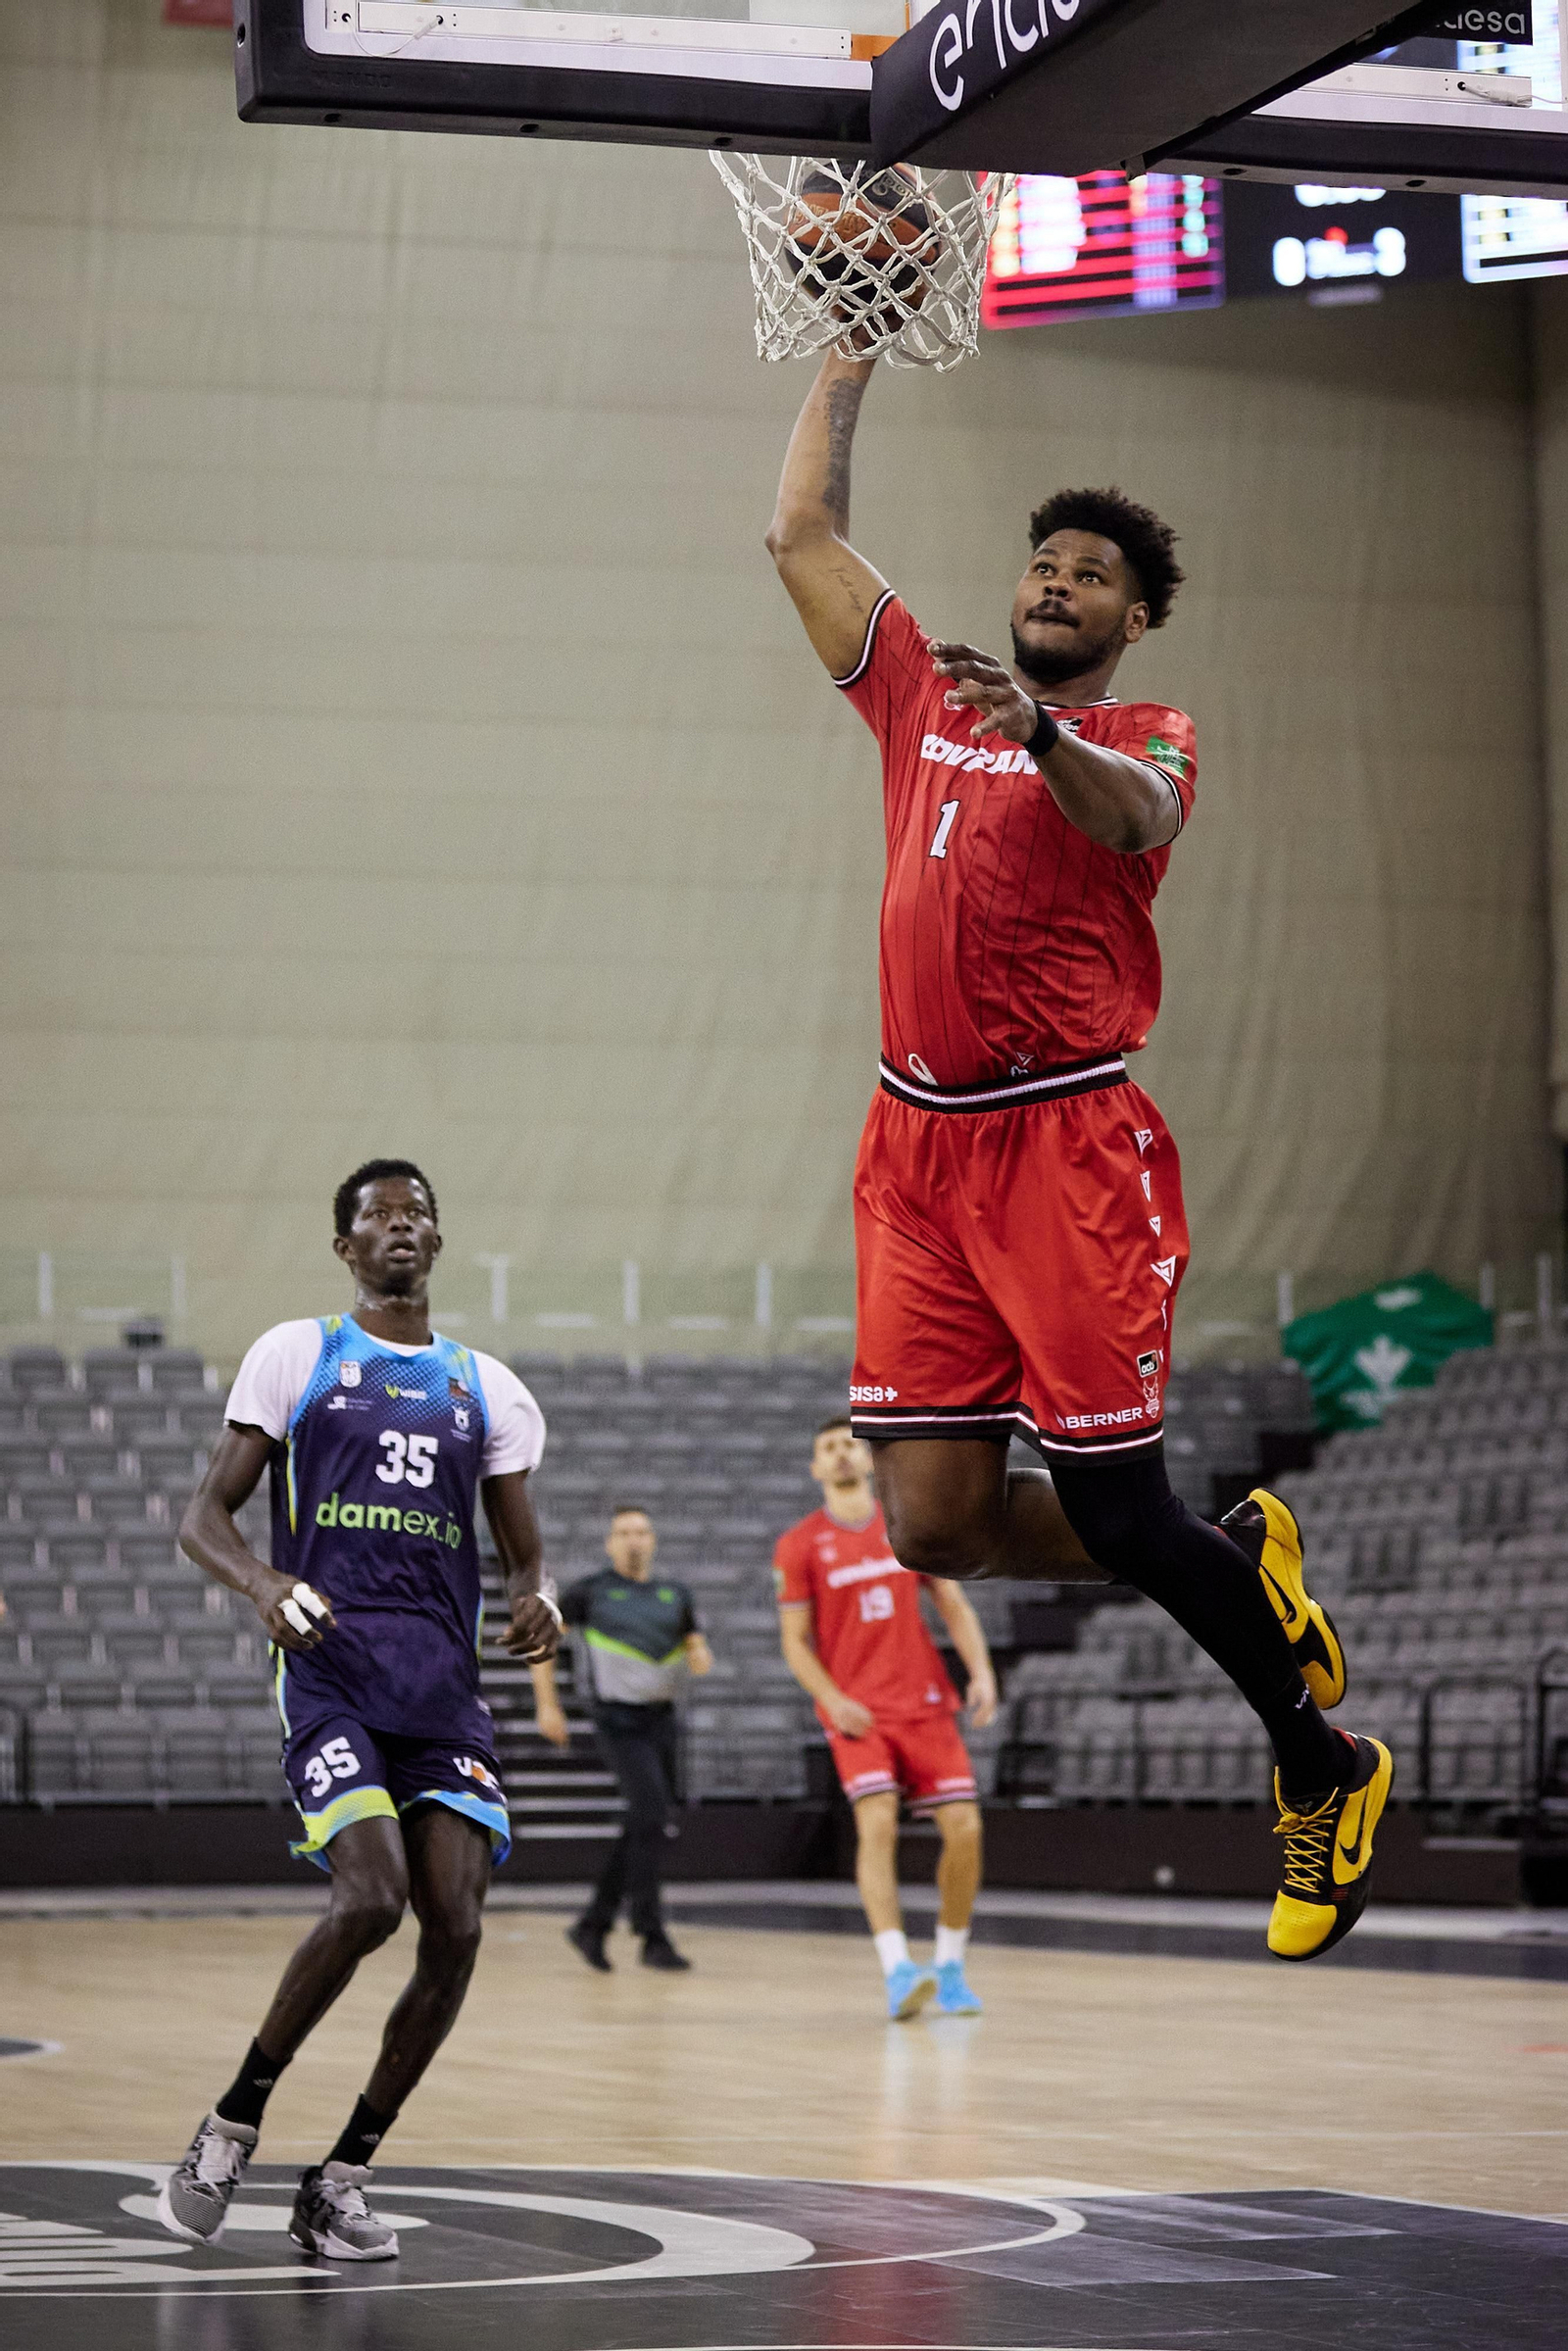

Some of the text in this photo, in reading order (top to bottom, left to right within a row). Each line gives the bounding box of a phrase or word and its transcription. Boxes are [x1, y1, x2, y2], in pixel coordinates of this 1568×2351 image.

[929, 799, 961, 859] 1
[1065, 1406, 1144, 1429] BERNER
[375, 1429, 439, 1489] 35
[316, 1493, 463, 1549] damex.io
[305, 1736, 362, 1798] 35
